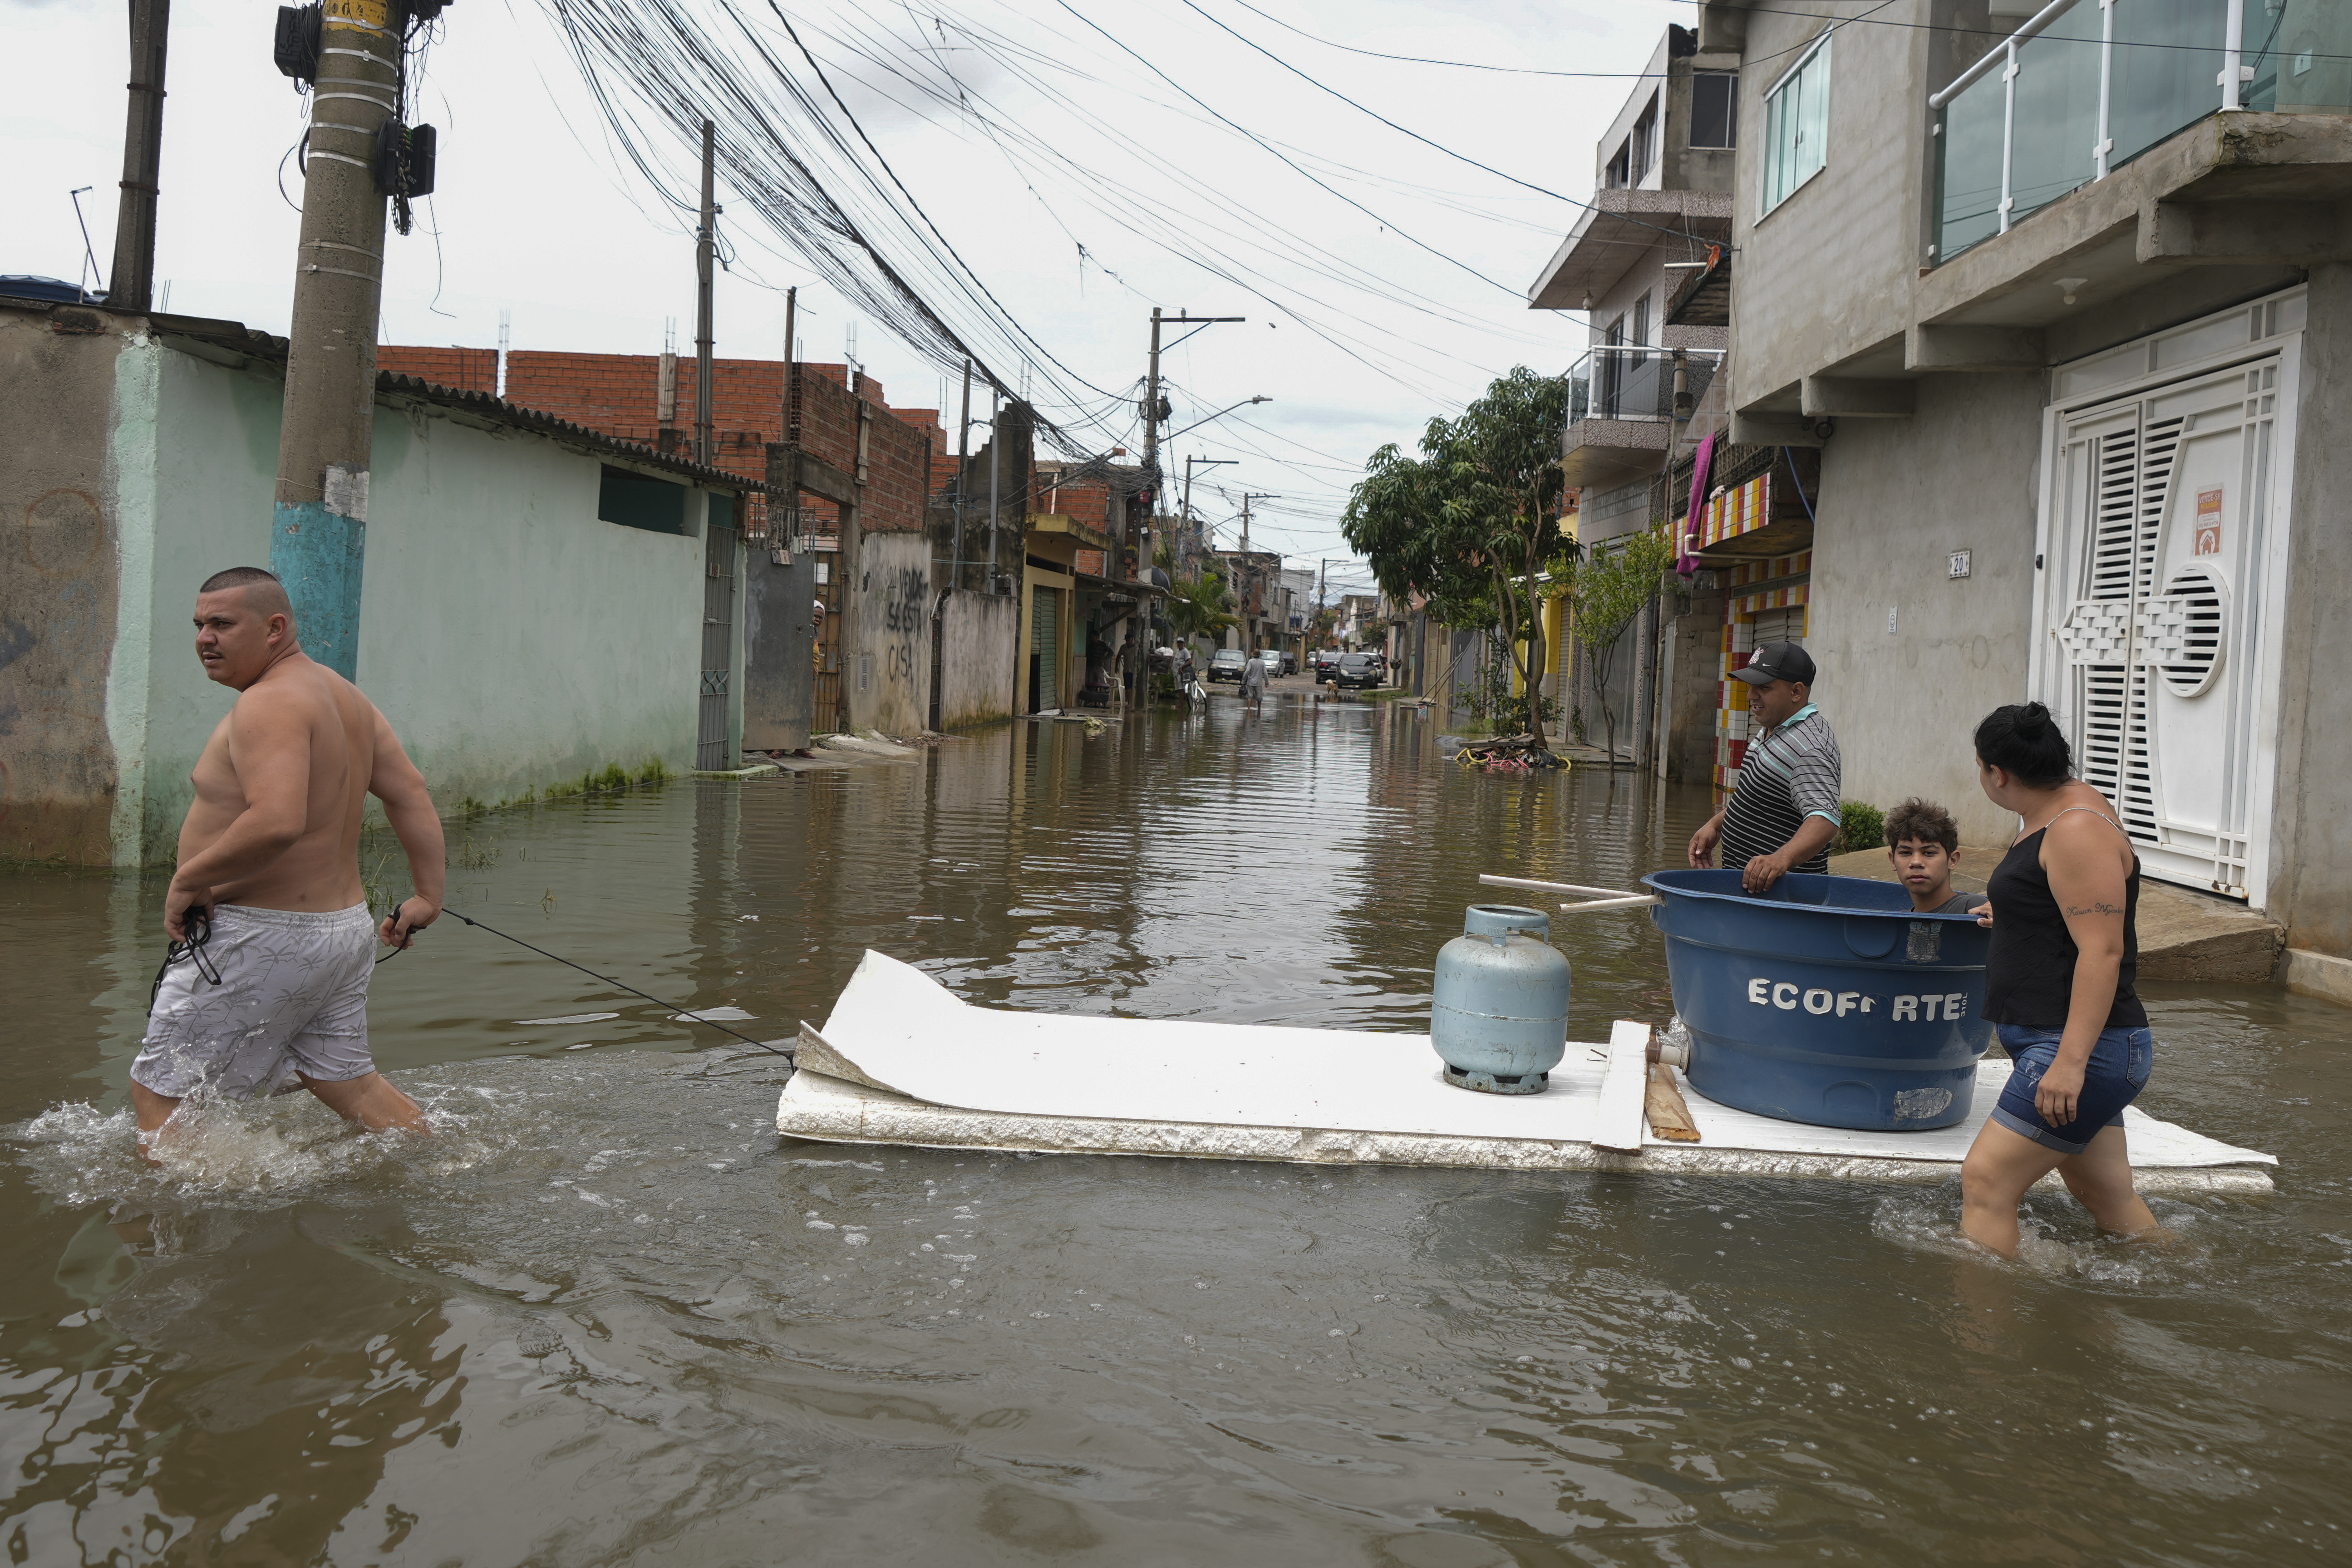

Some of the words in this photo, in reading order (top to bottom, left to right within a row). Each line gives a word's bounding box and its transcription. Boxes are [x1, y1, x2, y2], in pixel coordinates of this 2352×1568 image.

[2199, 493, 2221, 504] VENDE-SE
[1954, 557, 1963, 572] 20
[887, 601, 900, 634] SE
[889, 641, 914, 685] CASA
